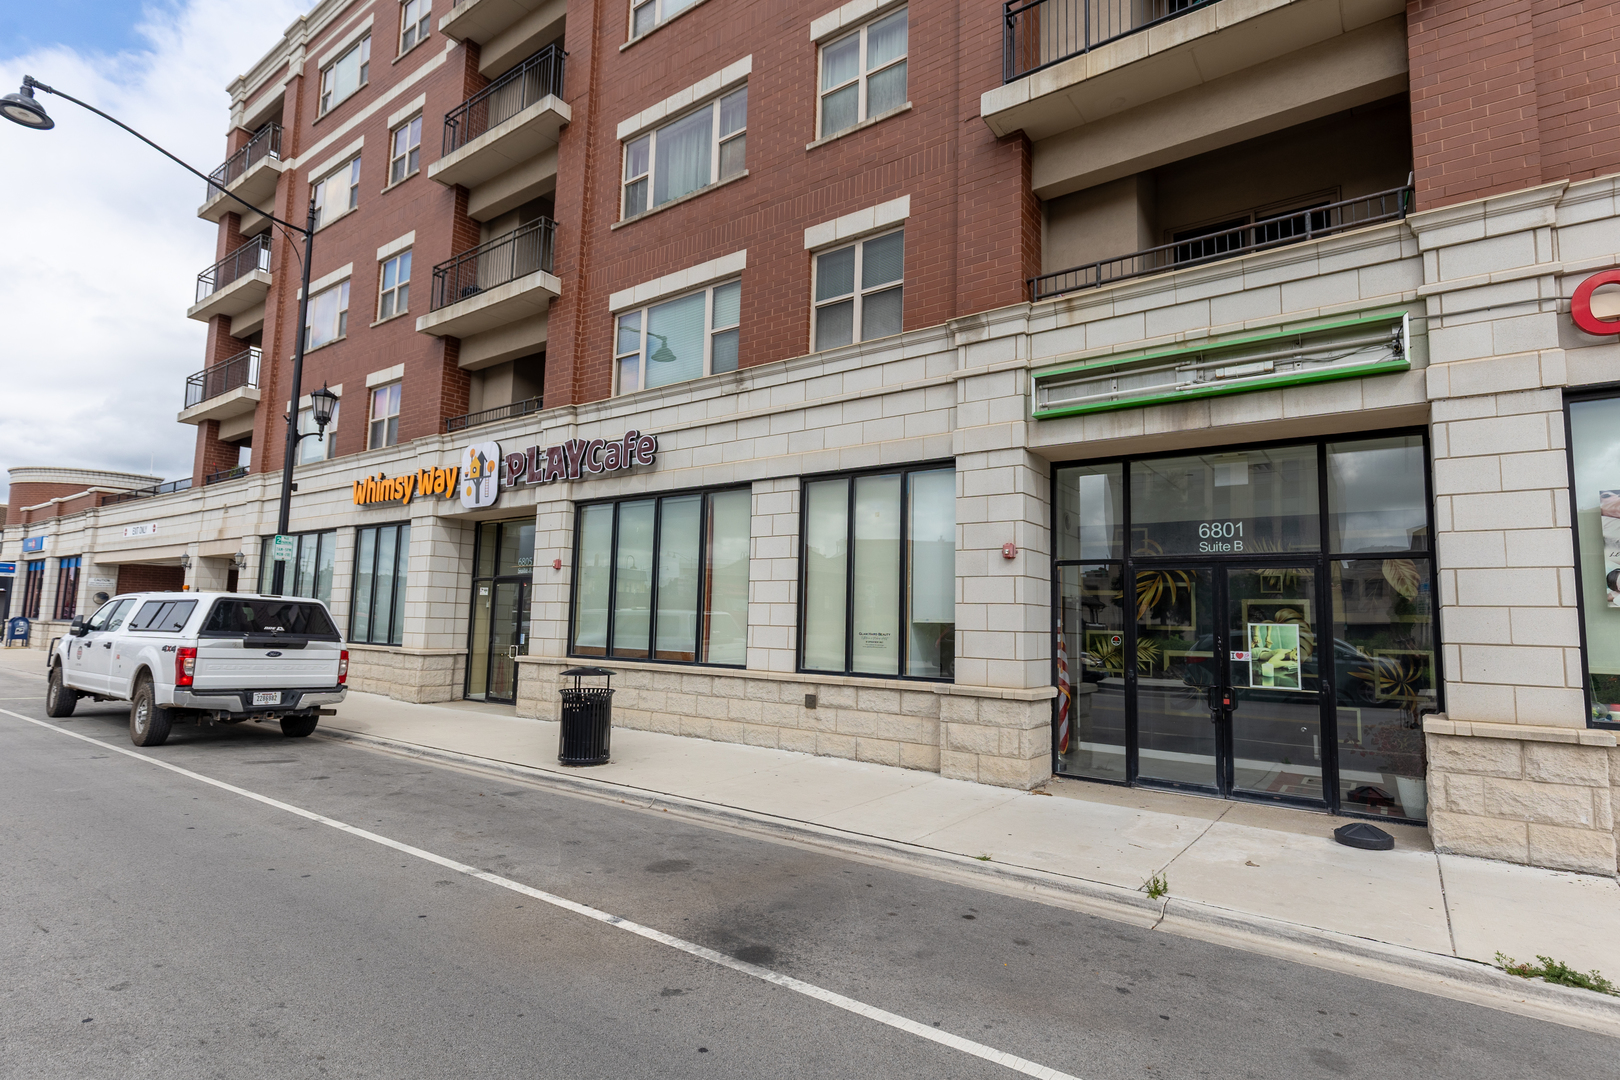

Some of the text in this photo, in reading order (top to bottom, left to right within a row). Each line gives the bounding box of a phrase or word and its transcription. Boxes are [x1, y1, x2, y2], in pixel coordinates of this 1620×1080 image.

[353, 466, 459, 505] Whimsy Way
[1198, 521, 1244, 538] 6801
[1199, 541, 1244, 553] Suite B
[518, 557, 532, 566] 6805
